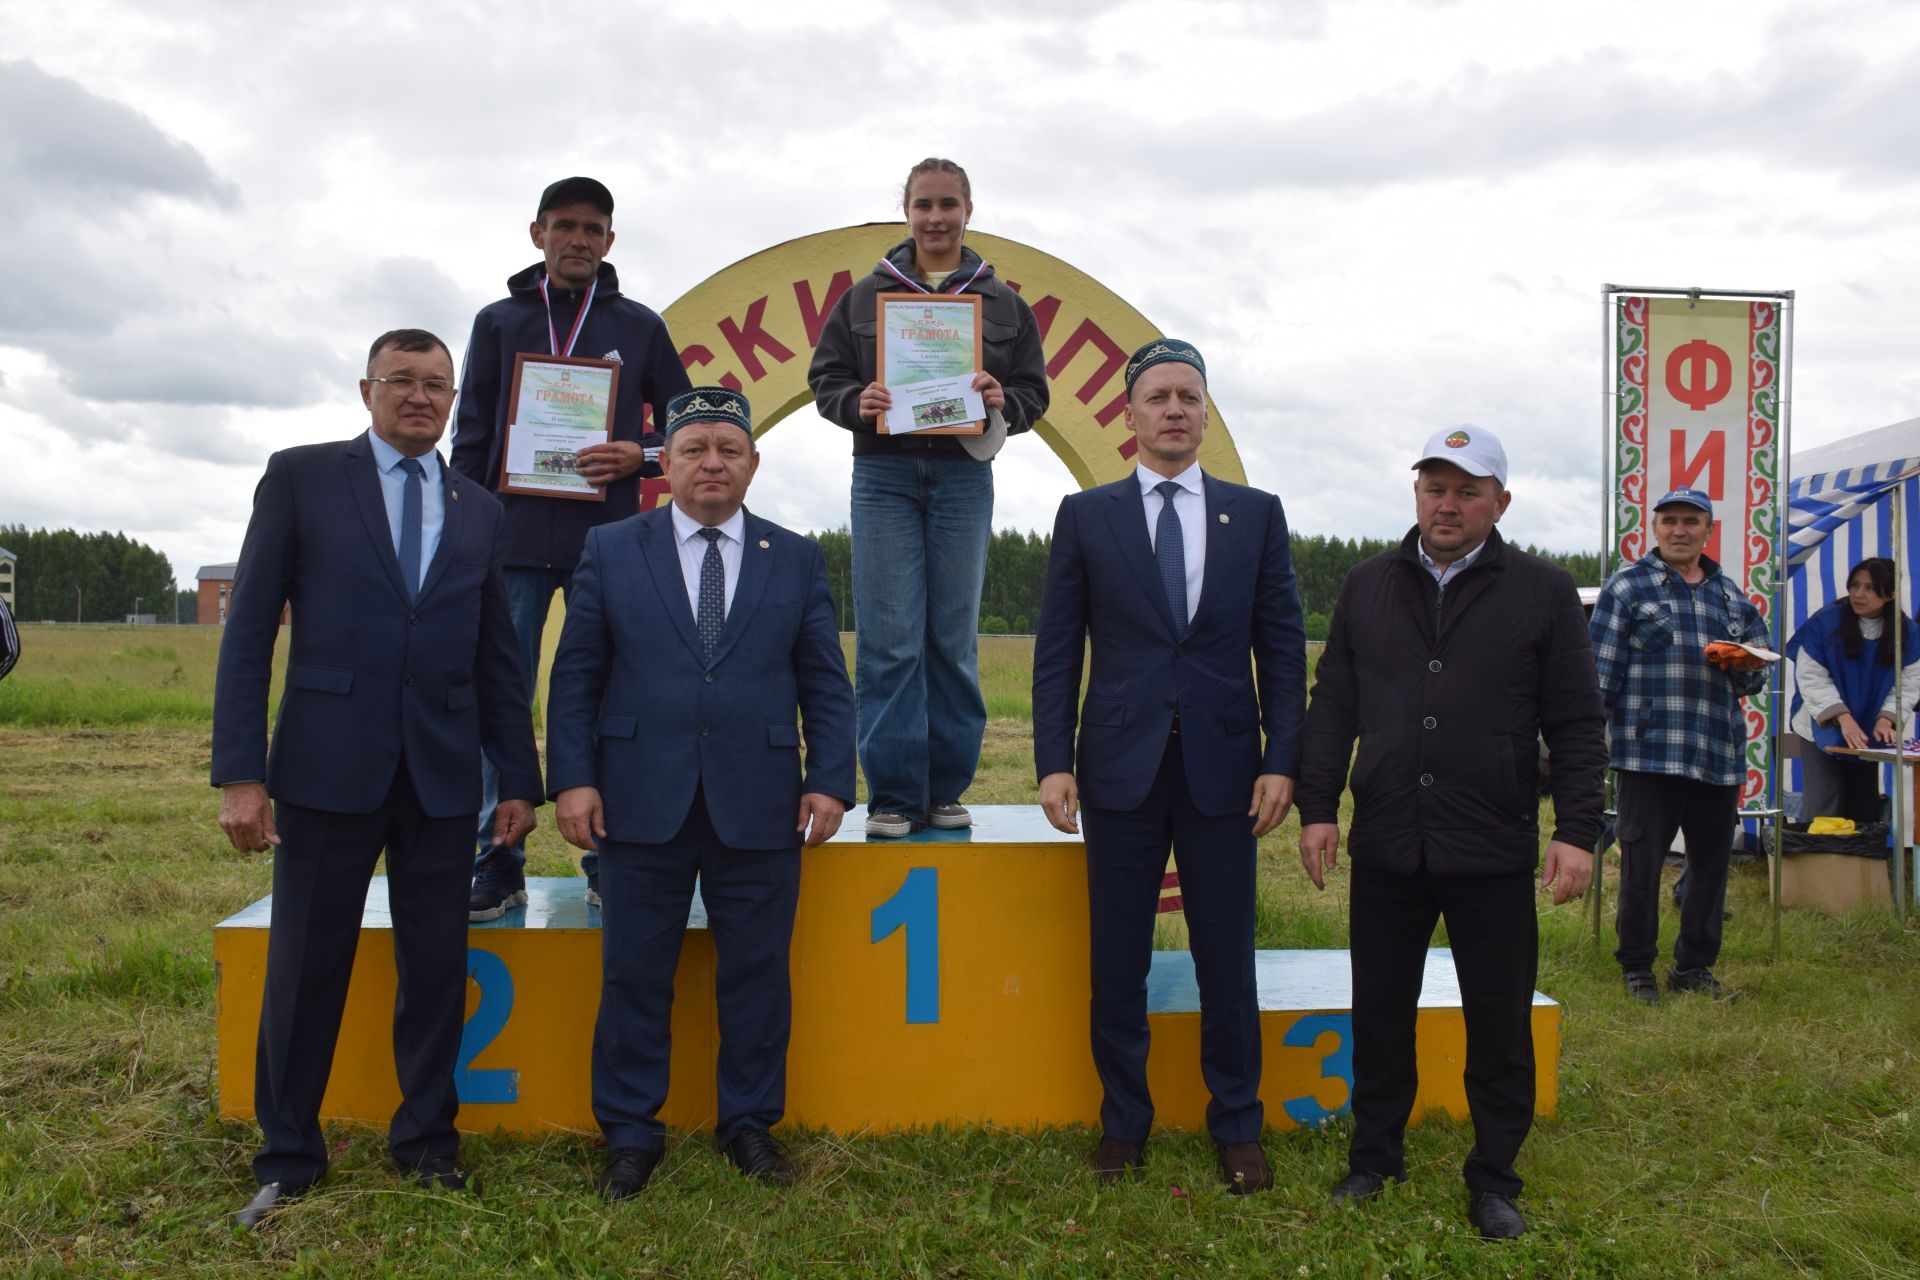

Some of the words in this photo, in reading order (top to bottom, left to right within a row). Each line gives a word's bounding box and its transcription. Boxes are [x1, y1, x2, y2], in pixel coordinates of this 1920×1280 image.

[535, 388, 594, 405] ГРАМОТА
[900, 328, 960, 340] ГРАМОТА
[1664, 338, 1732, 563] ФИ
[871, 867, 939, 1024] 1
[456, 947, 518, 1104] 2
[1282, 1013, 1354, 1128] 3
